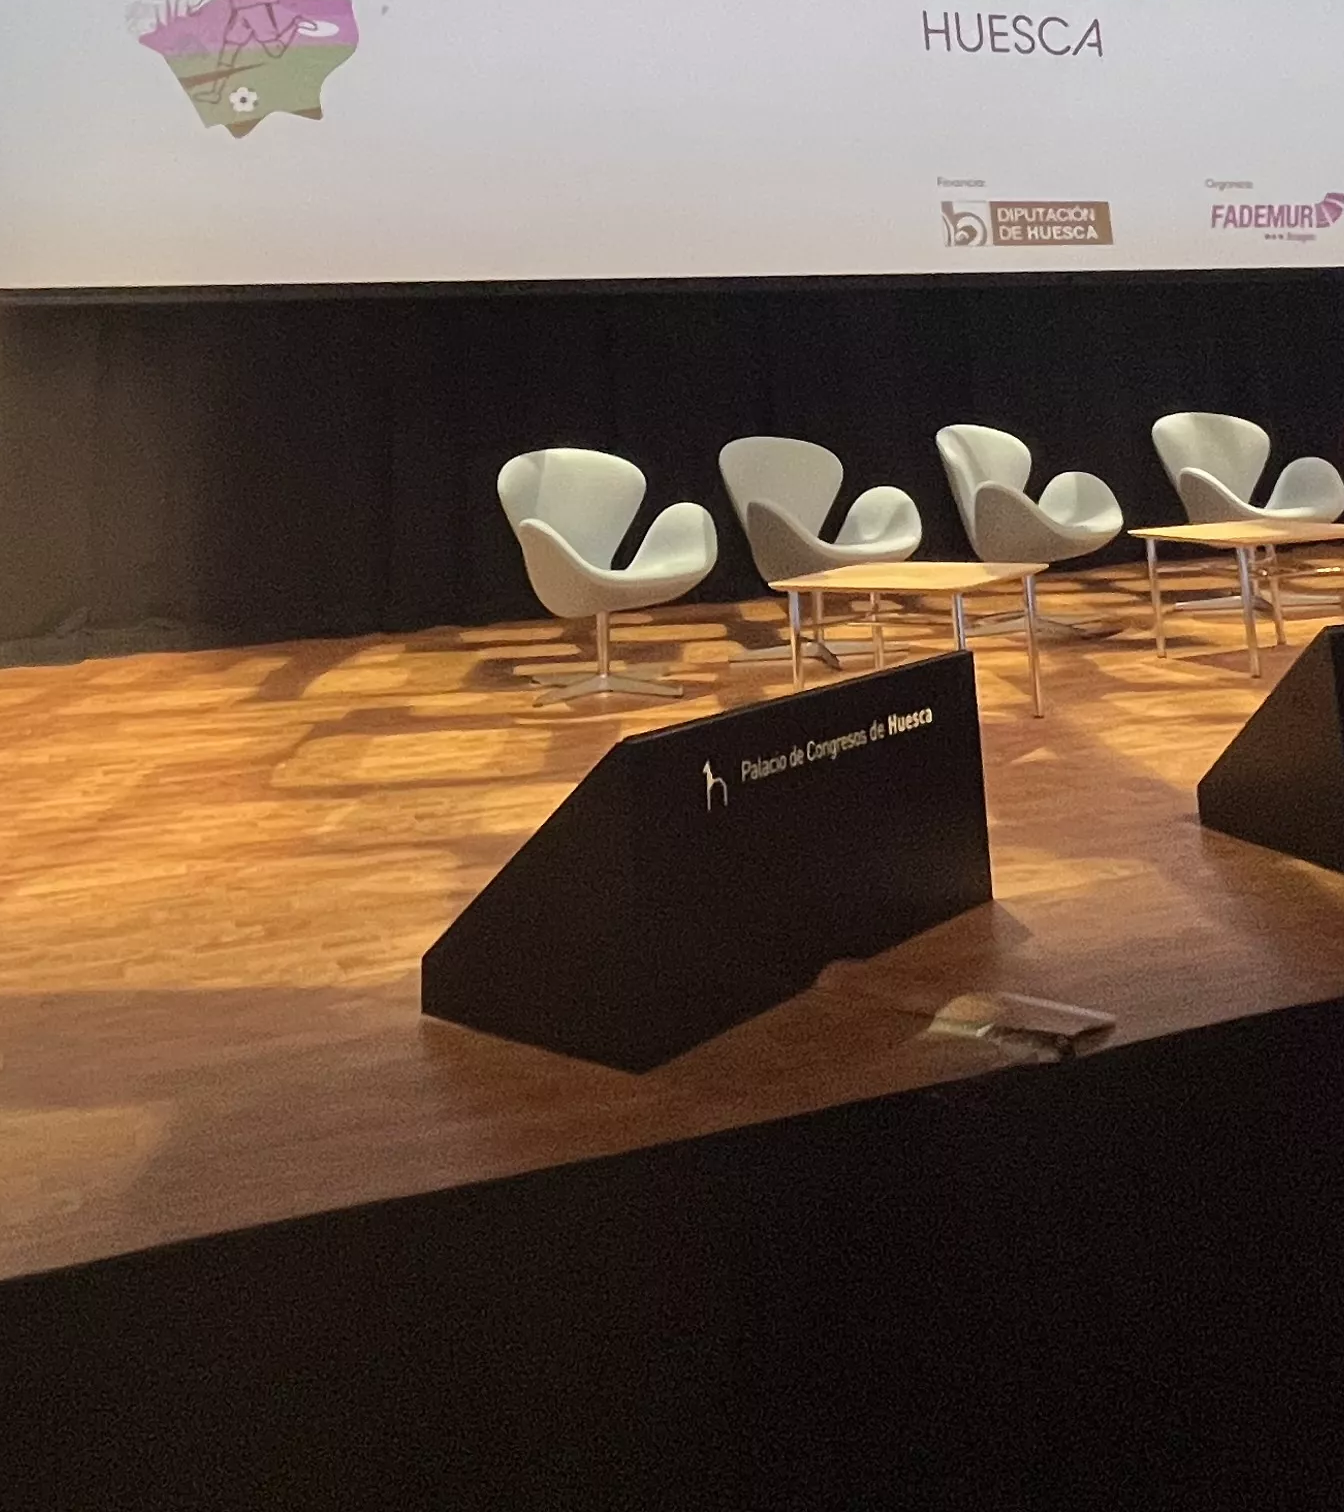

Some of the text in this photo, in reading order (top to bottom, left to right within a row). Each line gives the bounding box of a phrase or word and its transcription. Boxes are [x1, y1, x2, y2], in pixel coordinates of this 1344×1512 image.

[923, 10, 1104, 58] HUESCA
[996, 205, 1096, 224] DIPUTACIÓN
[1210, 205, 1313, 229] FADEMUR
[999, 225, 1099, 240] DE HUESCA
[741, 707, 933, 782] Palacio de Congresos de Huesca
